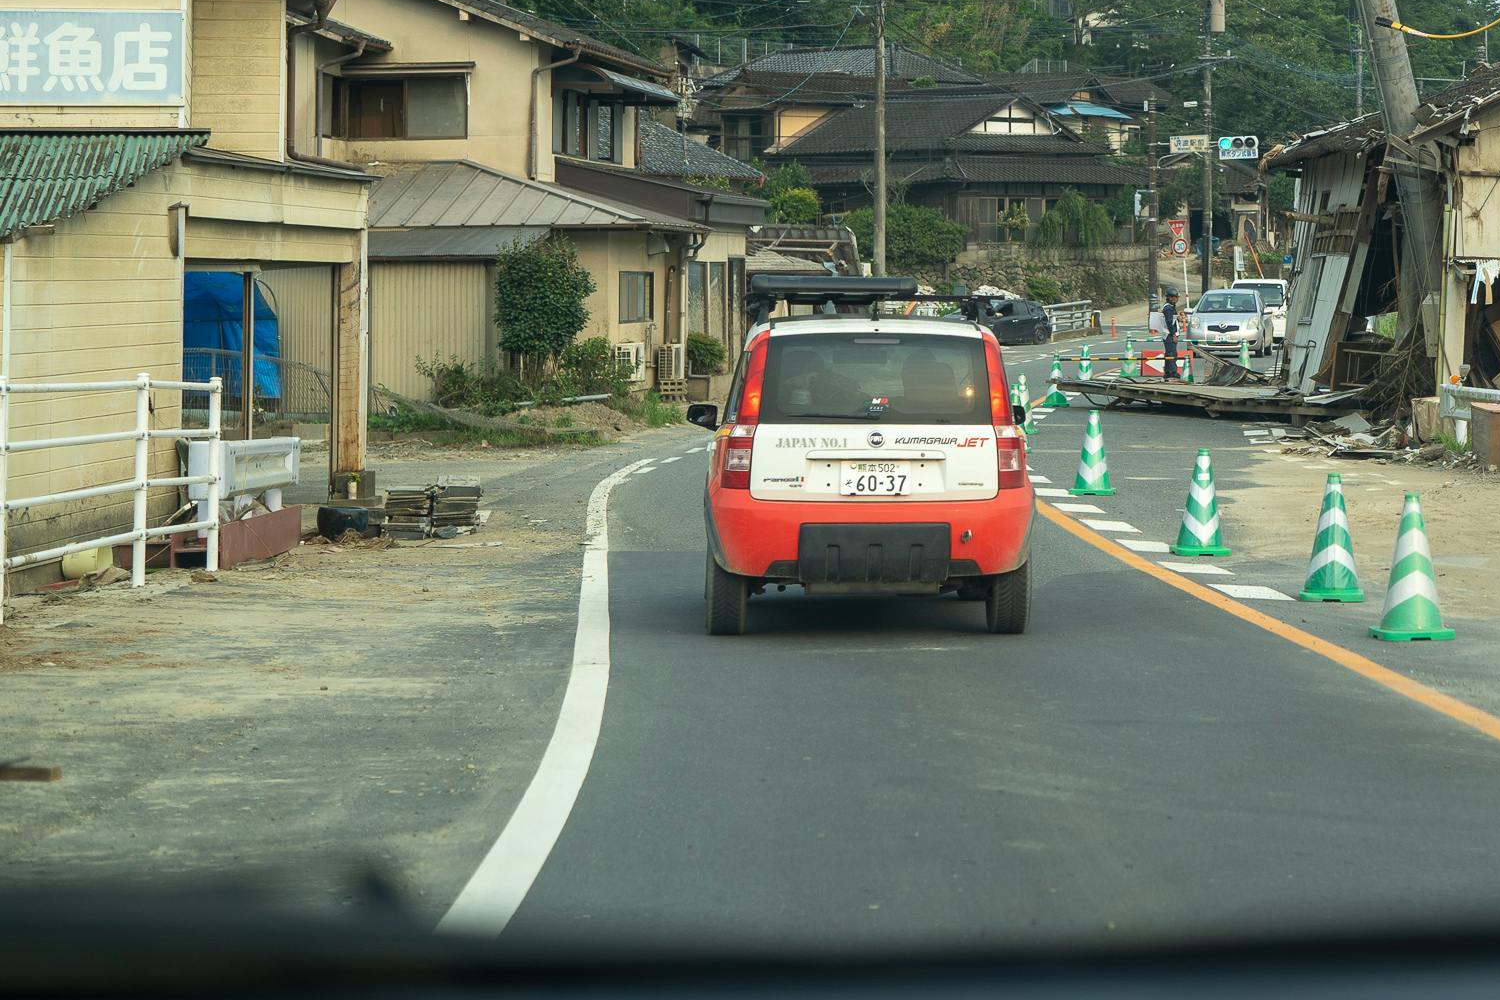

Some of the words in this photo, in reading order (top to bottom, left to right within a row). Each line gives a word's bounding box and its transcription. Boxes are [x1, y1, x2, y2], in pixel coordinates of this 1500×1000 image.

[0, 22, 173, 92] 鮮魚店
[1175, 242, 1185, 250] 30
[776, 438, 817, 448] JAPAN
[821, 438, 848, 448] NO.1
[957, 438, 990, 447] JET
[878, 463, 896, 473] 502
[856, 475, 907, 492] 60-37
